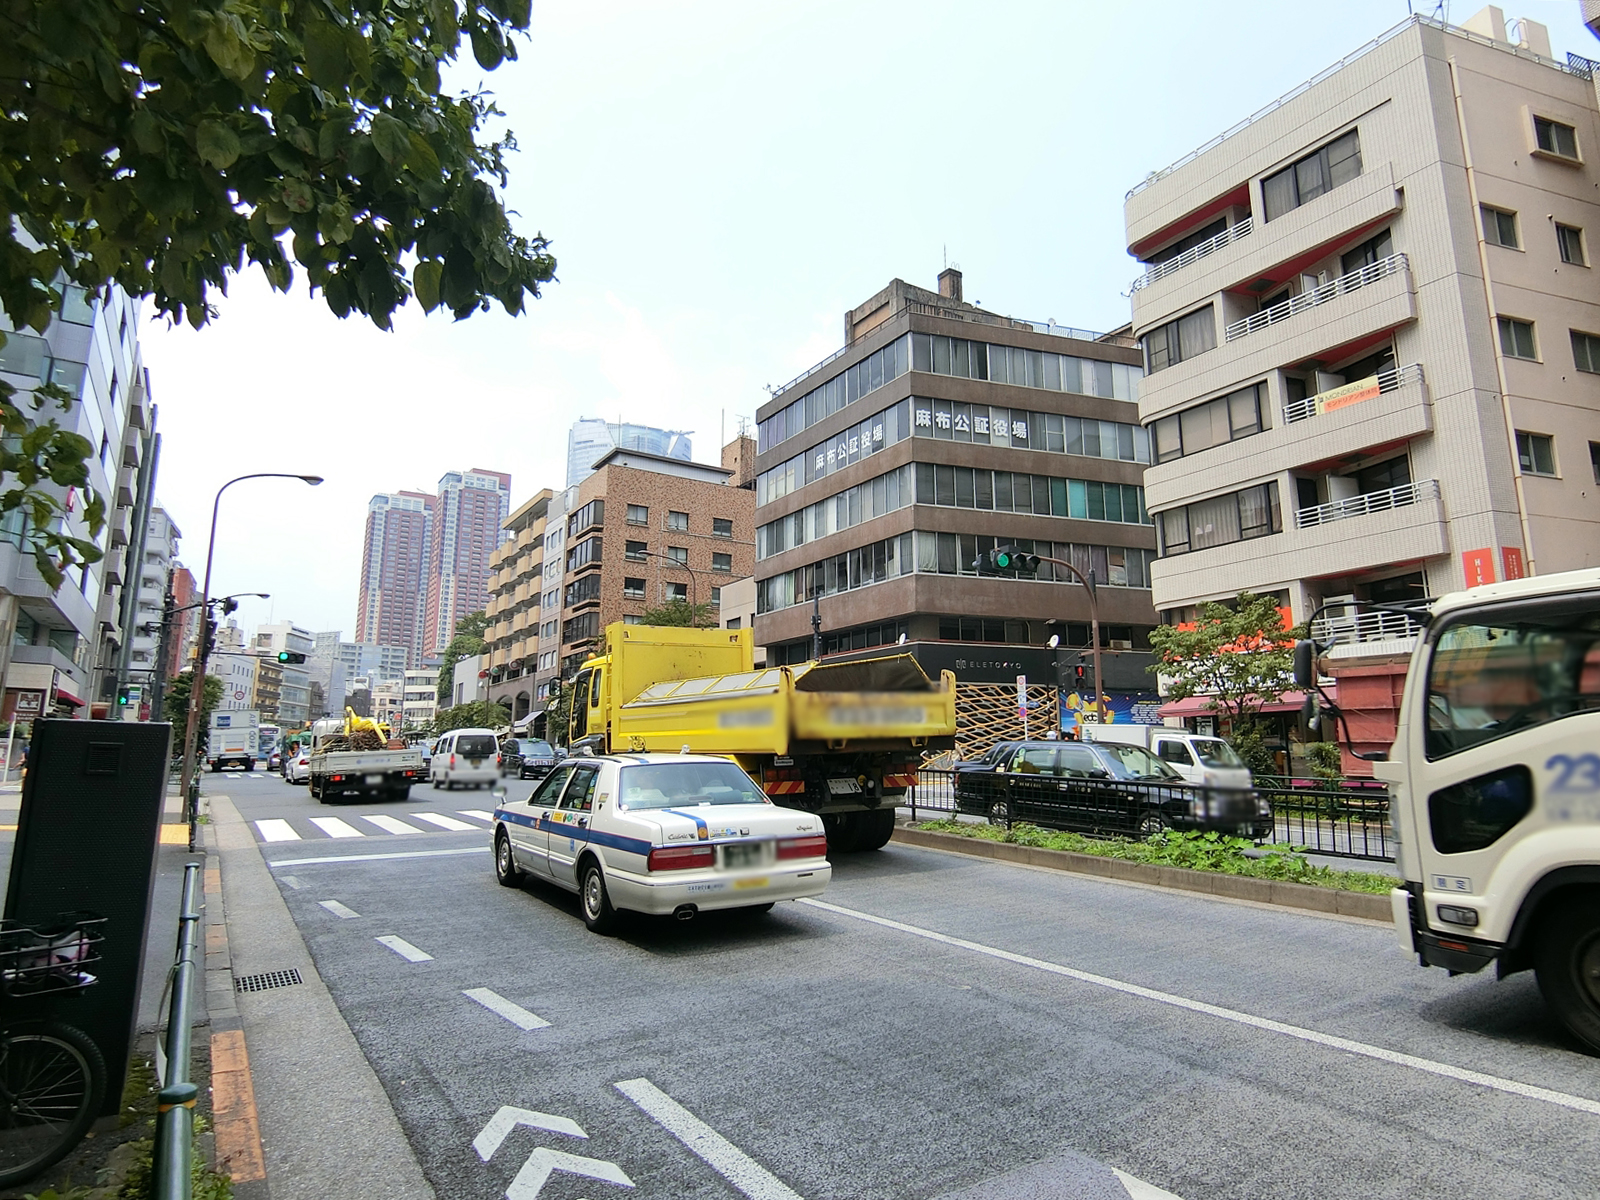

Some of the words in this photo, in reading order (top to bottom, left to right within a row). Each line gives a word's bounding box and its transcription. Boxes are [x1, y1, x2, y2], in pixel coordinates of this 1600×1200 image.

[1325, 384, 1364, 400] MONDRIAN
[915, 409, 1027, 439] 麻布公証役場
[815, 423, 883, 471] 麻布公証役場
[1474, 558, 1483, 587] HIK
[1083, 713, 1097, 722] edc
